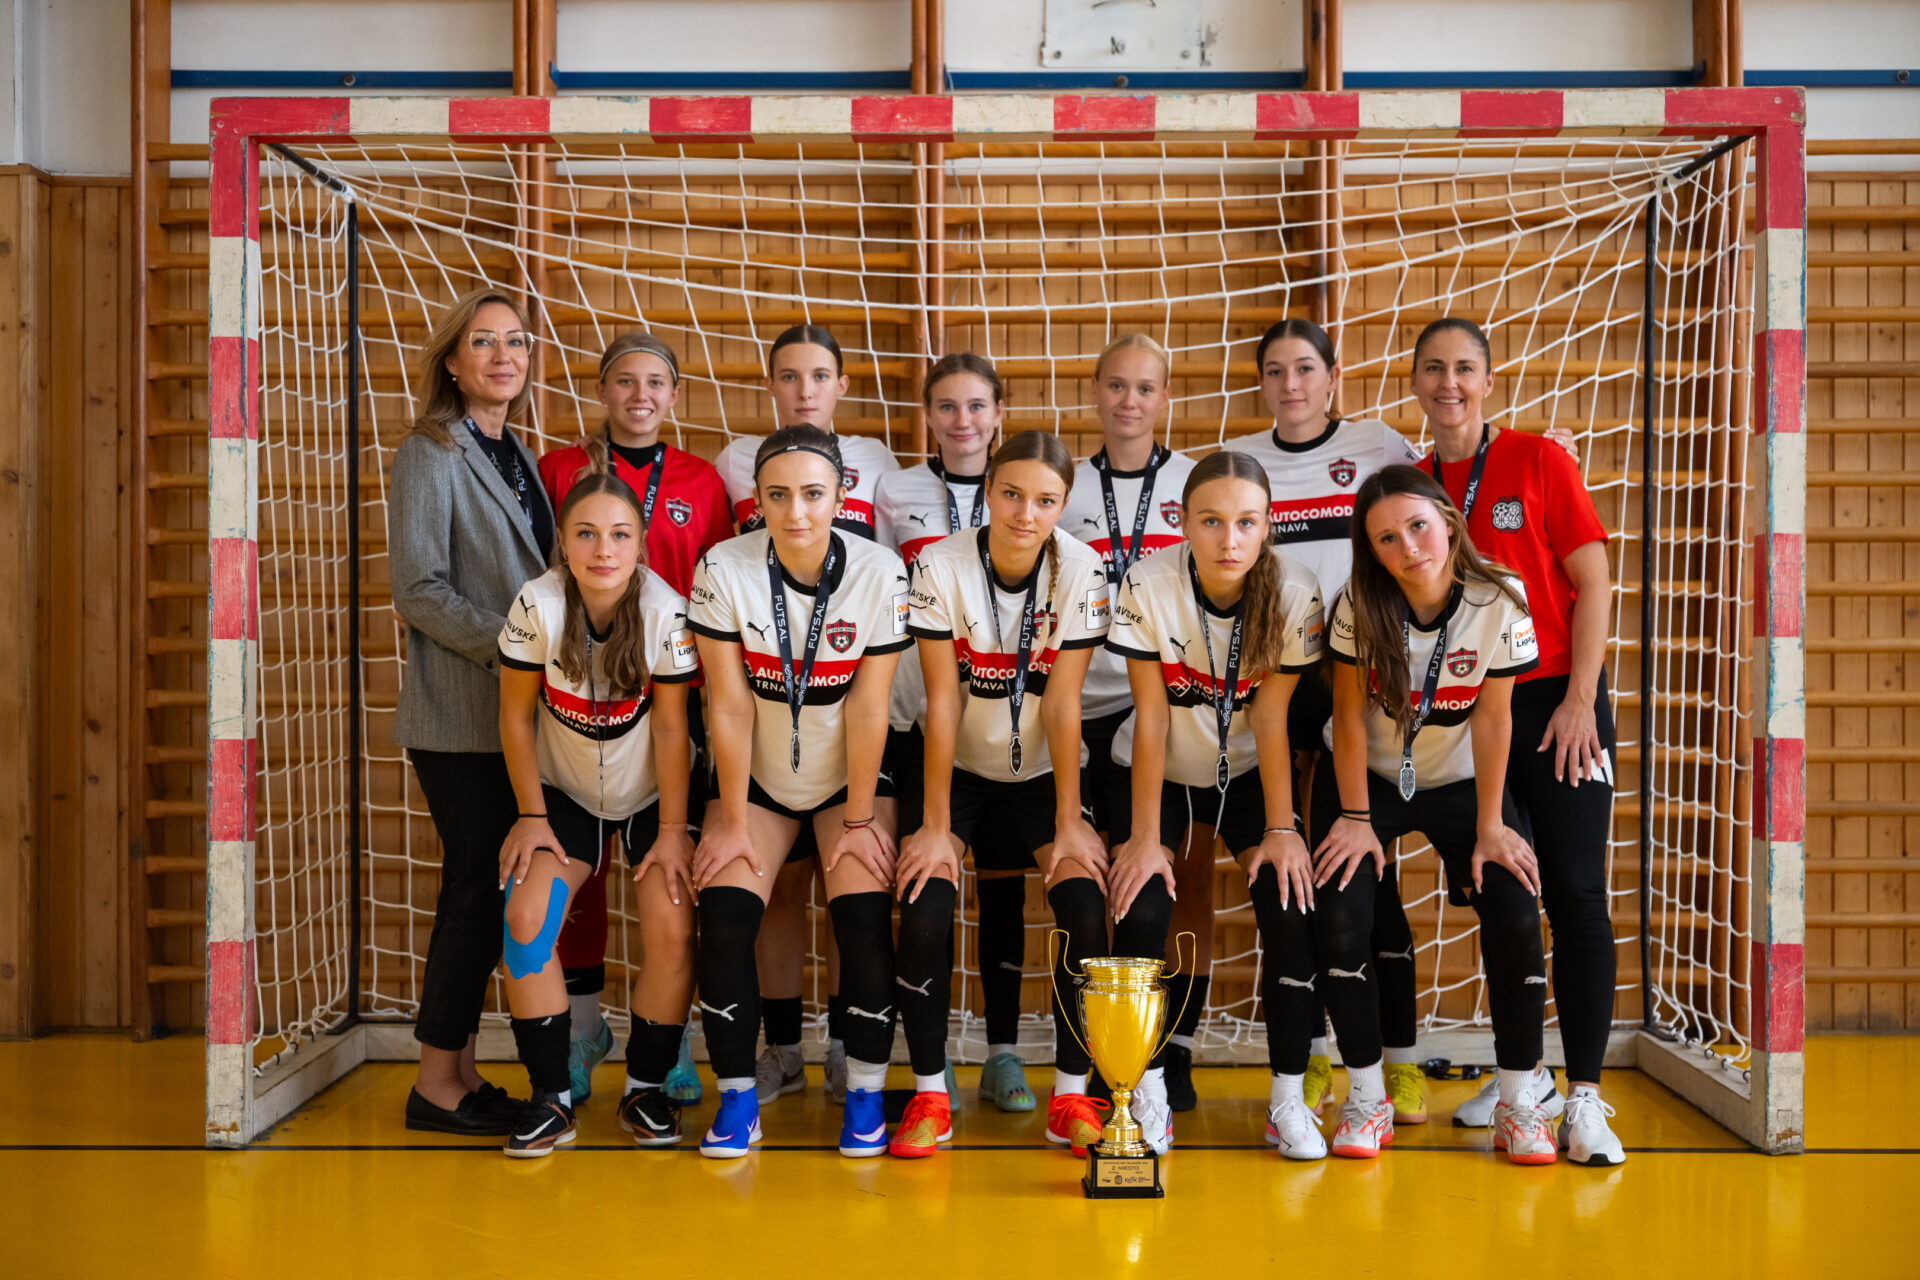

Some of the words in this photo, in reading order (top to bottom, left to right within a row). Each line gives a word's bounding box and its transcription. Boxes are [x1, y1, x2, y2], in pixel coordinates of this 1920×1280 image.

[513, 453, 526, 491] FUTSA
[644, 485, 656, 521] FUTSA
[1105, 492, 1117, 533] FUTSAL
[1136, 490, 1150, 530] FUTSAL
[1272, 522, 1309, 533] RNAVA
[774, 594, 788, 644] FUTSAL
[808, 601, 826, 649] FUTSAL
[1021, 600, 1034, 649] FUTSAL
[1229, 620, 1242, 668] FUTSAL
[1429, 630, 1446, 678] FUTSAL
